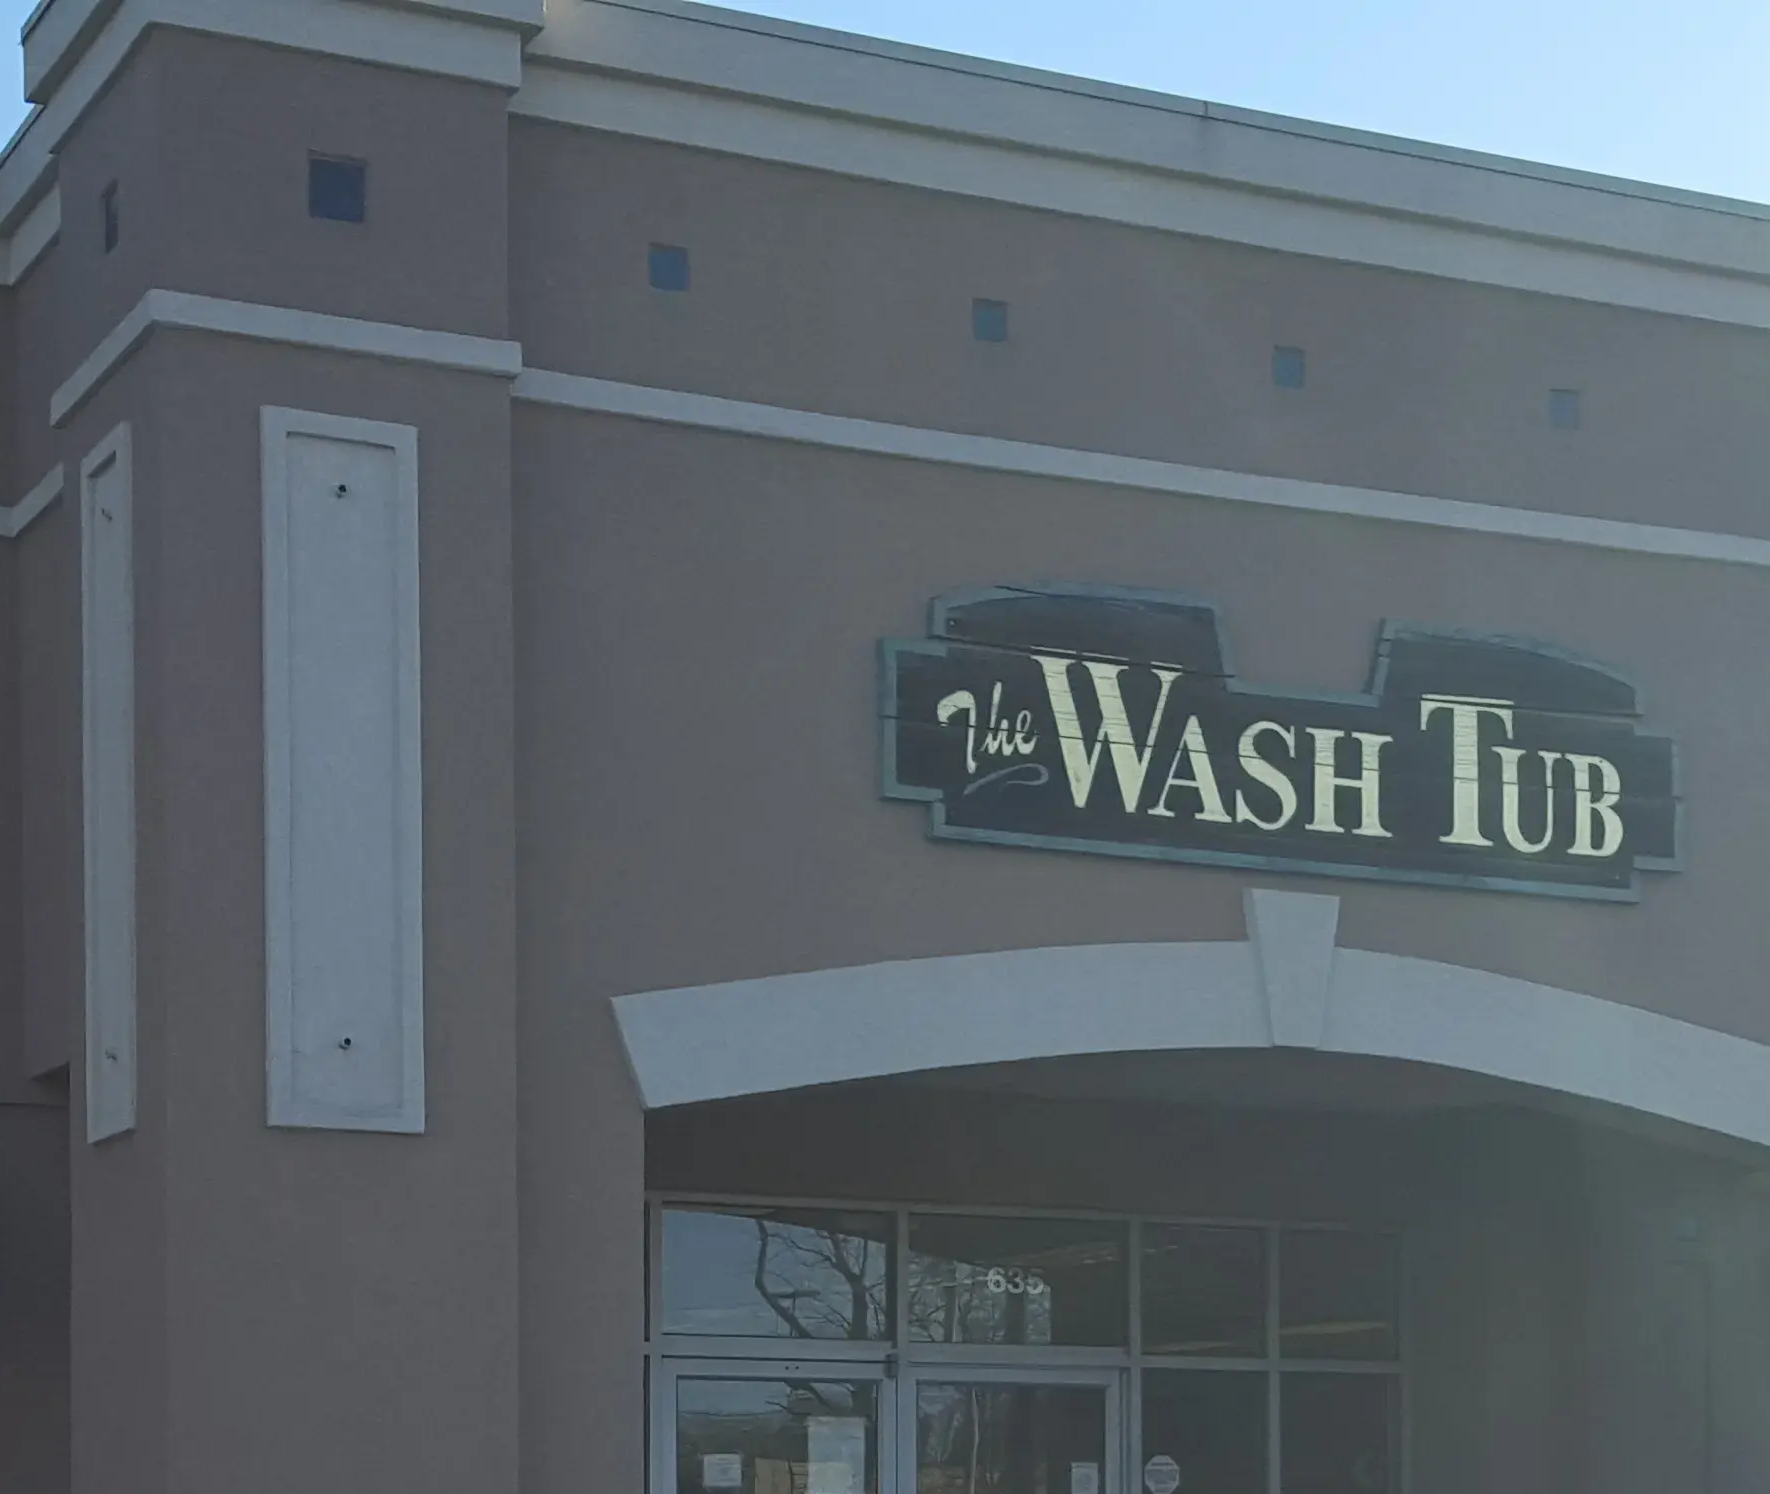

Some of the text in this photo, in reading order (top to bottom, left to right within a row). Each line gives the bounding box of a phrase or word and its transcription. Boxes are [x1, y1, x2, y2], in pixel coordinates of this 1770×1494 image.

[936, 646, 1624, 858] The WASH TUB
[987, 1266, 1044, 1295] 635
